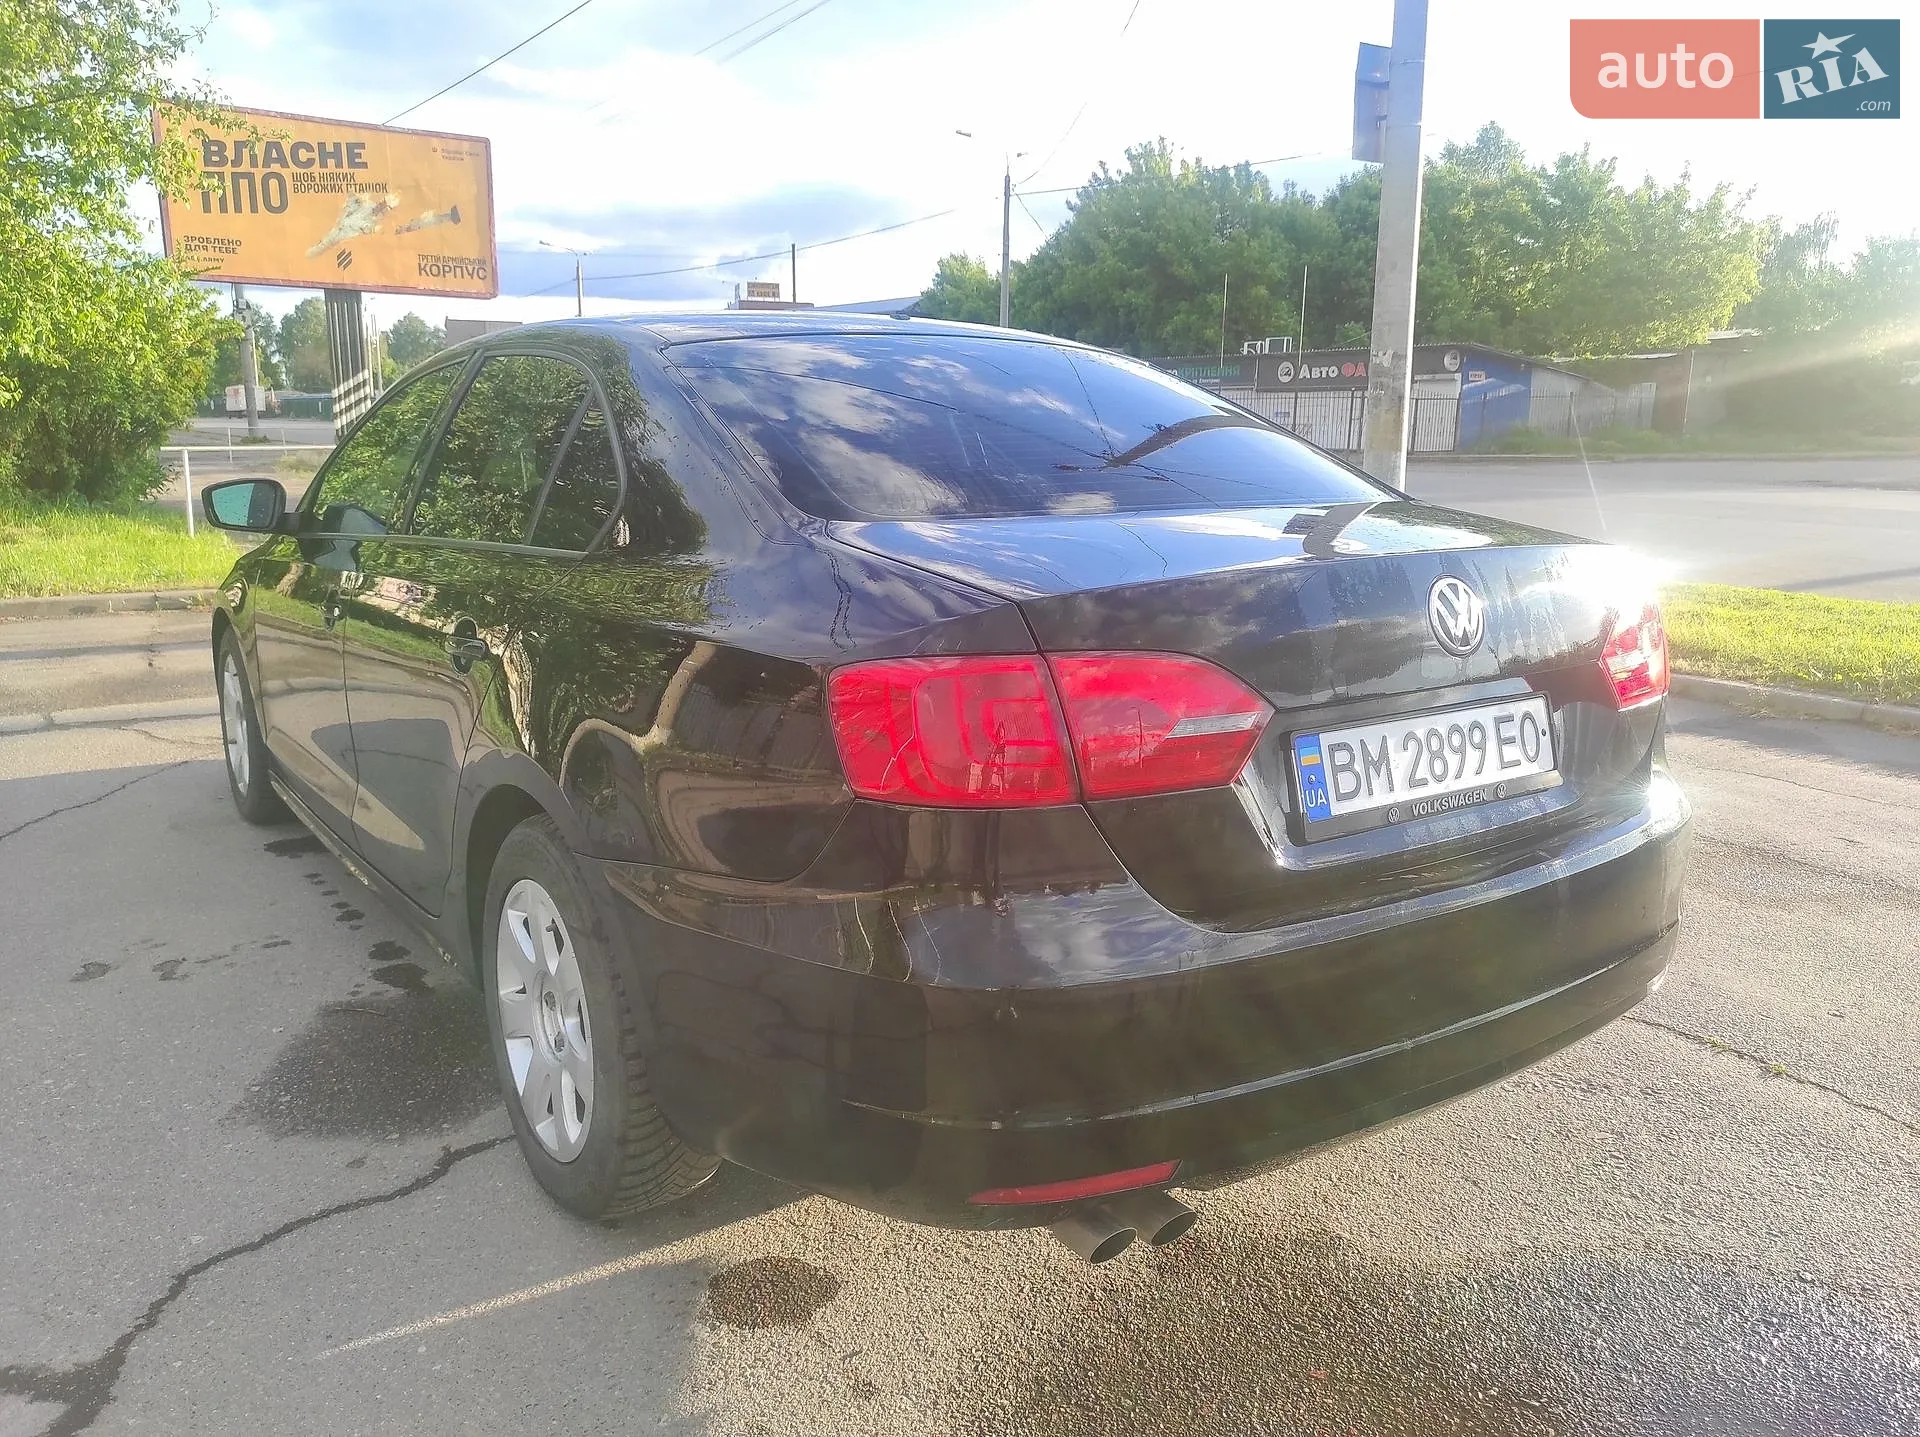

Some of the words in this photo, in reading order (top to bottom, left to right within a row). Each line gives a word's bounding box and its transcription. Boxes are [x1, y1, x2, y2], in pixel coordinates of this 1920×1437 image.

[202, 139, 369, 170] ВЛАСНЕ
[291, 171, 317, 184] ЩОБ
[318, 172, 356, 184] НІЯКИХ
[201, 170, 289, 215] ППО
[293, 182, 344, 194] ВОРОЖИХ
[183, 235, 242, 247] ЗРОБЛЕНО
[184, 243, 209, 253] ДЛЯ
[210, 245, 239, 255] ТЕБЕ
[417, 262, 488, 281] КОРПУС
[1327, 733, 1395, 803] BM
[1402, 719, 1487, 789] 2899
[1493, 710, 1542, 770] EO
[1305, 789, 1328, 808] UA
[1411, 788, 1488, 817] VOLKSWAGEN
